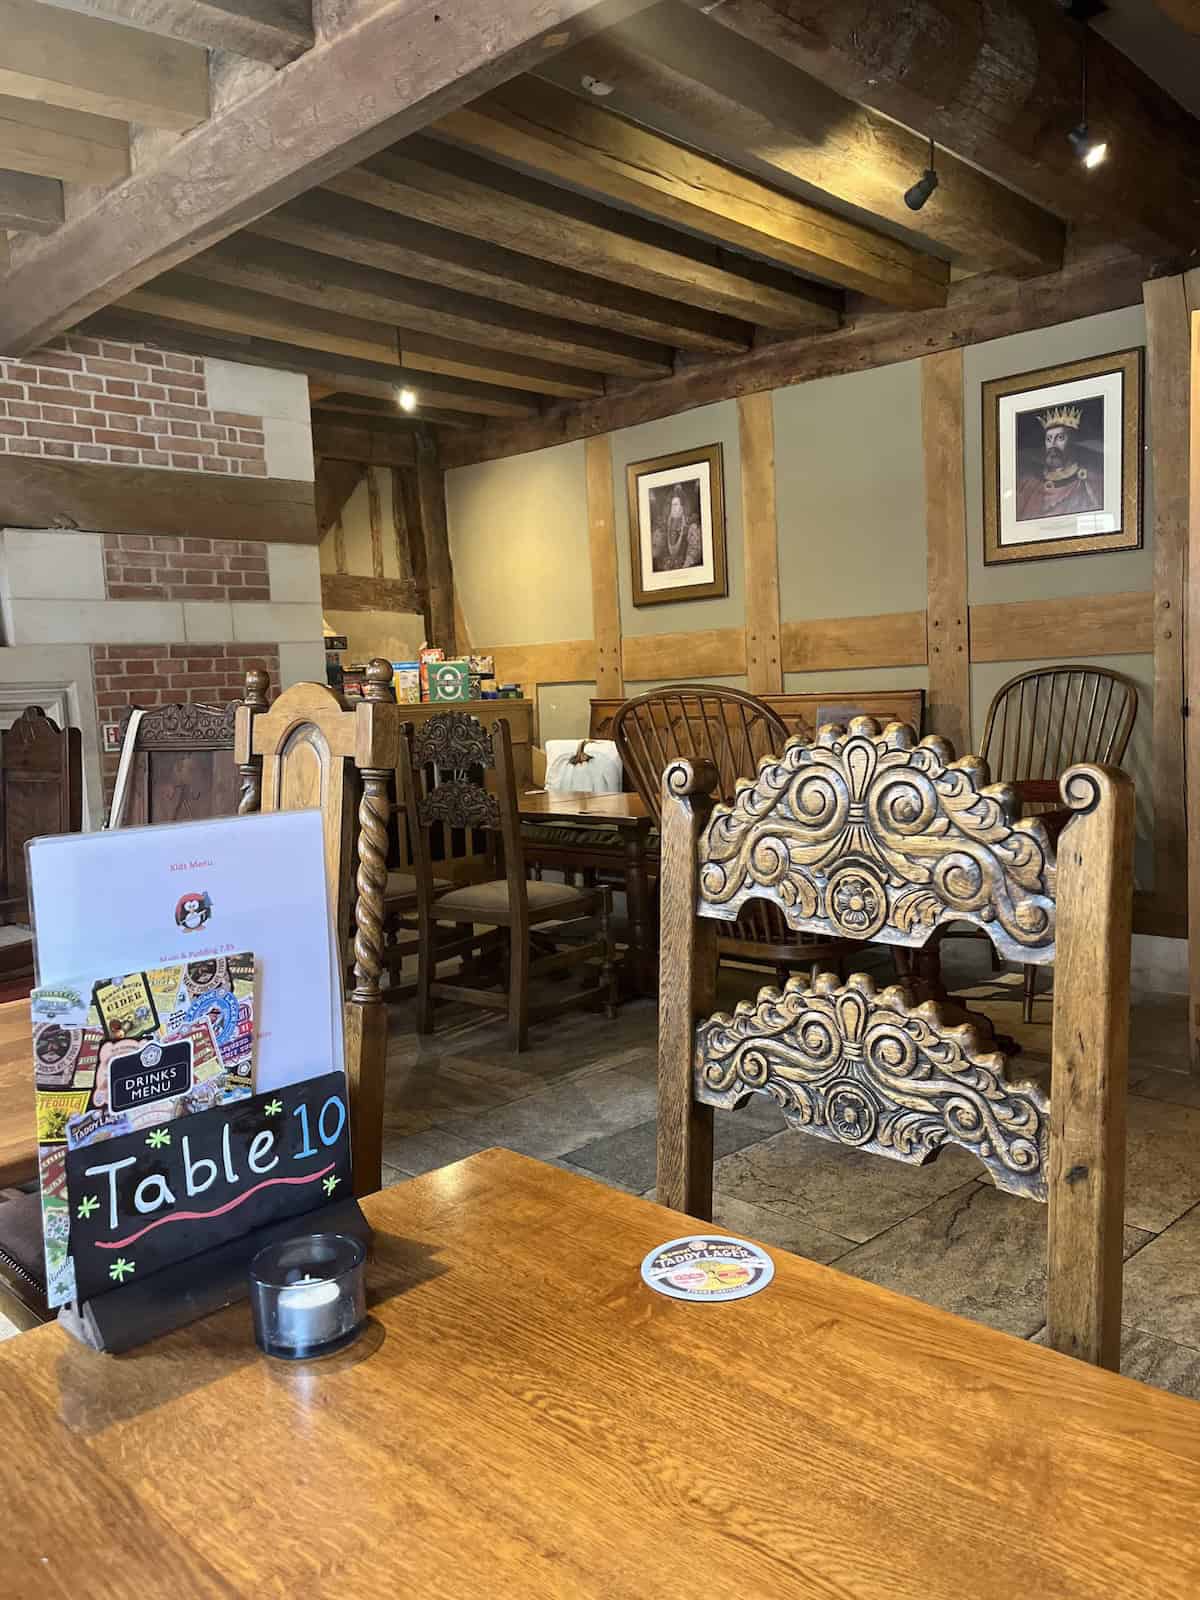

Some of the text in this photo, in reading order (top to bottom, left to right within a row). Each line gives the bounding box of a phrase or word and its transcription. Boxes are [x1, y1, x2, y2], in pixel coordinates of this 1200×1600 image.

[169, 859, 214, 872] Kids Menu
[106, 992, 142, 1012] CIDER
[125, 1067, 177, 1090] DRINKS
[132, 1080, 171, 1101] MENU
[72, 1120, 98, 1143] TADDY
[84, 1095, 346, 1230] Table 10
[655, 1251, 700, 1269] TADDY
[705, 1248, 752, 1259] LAGER
